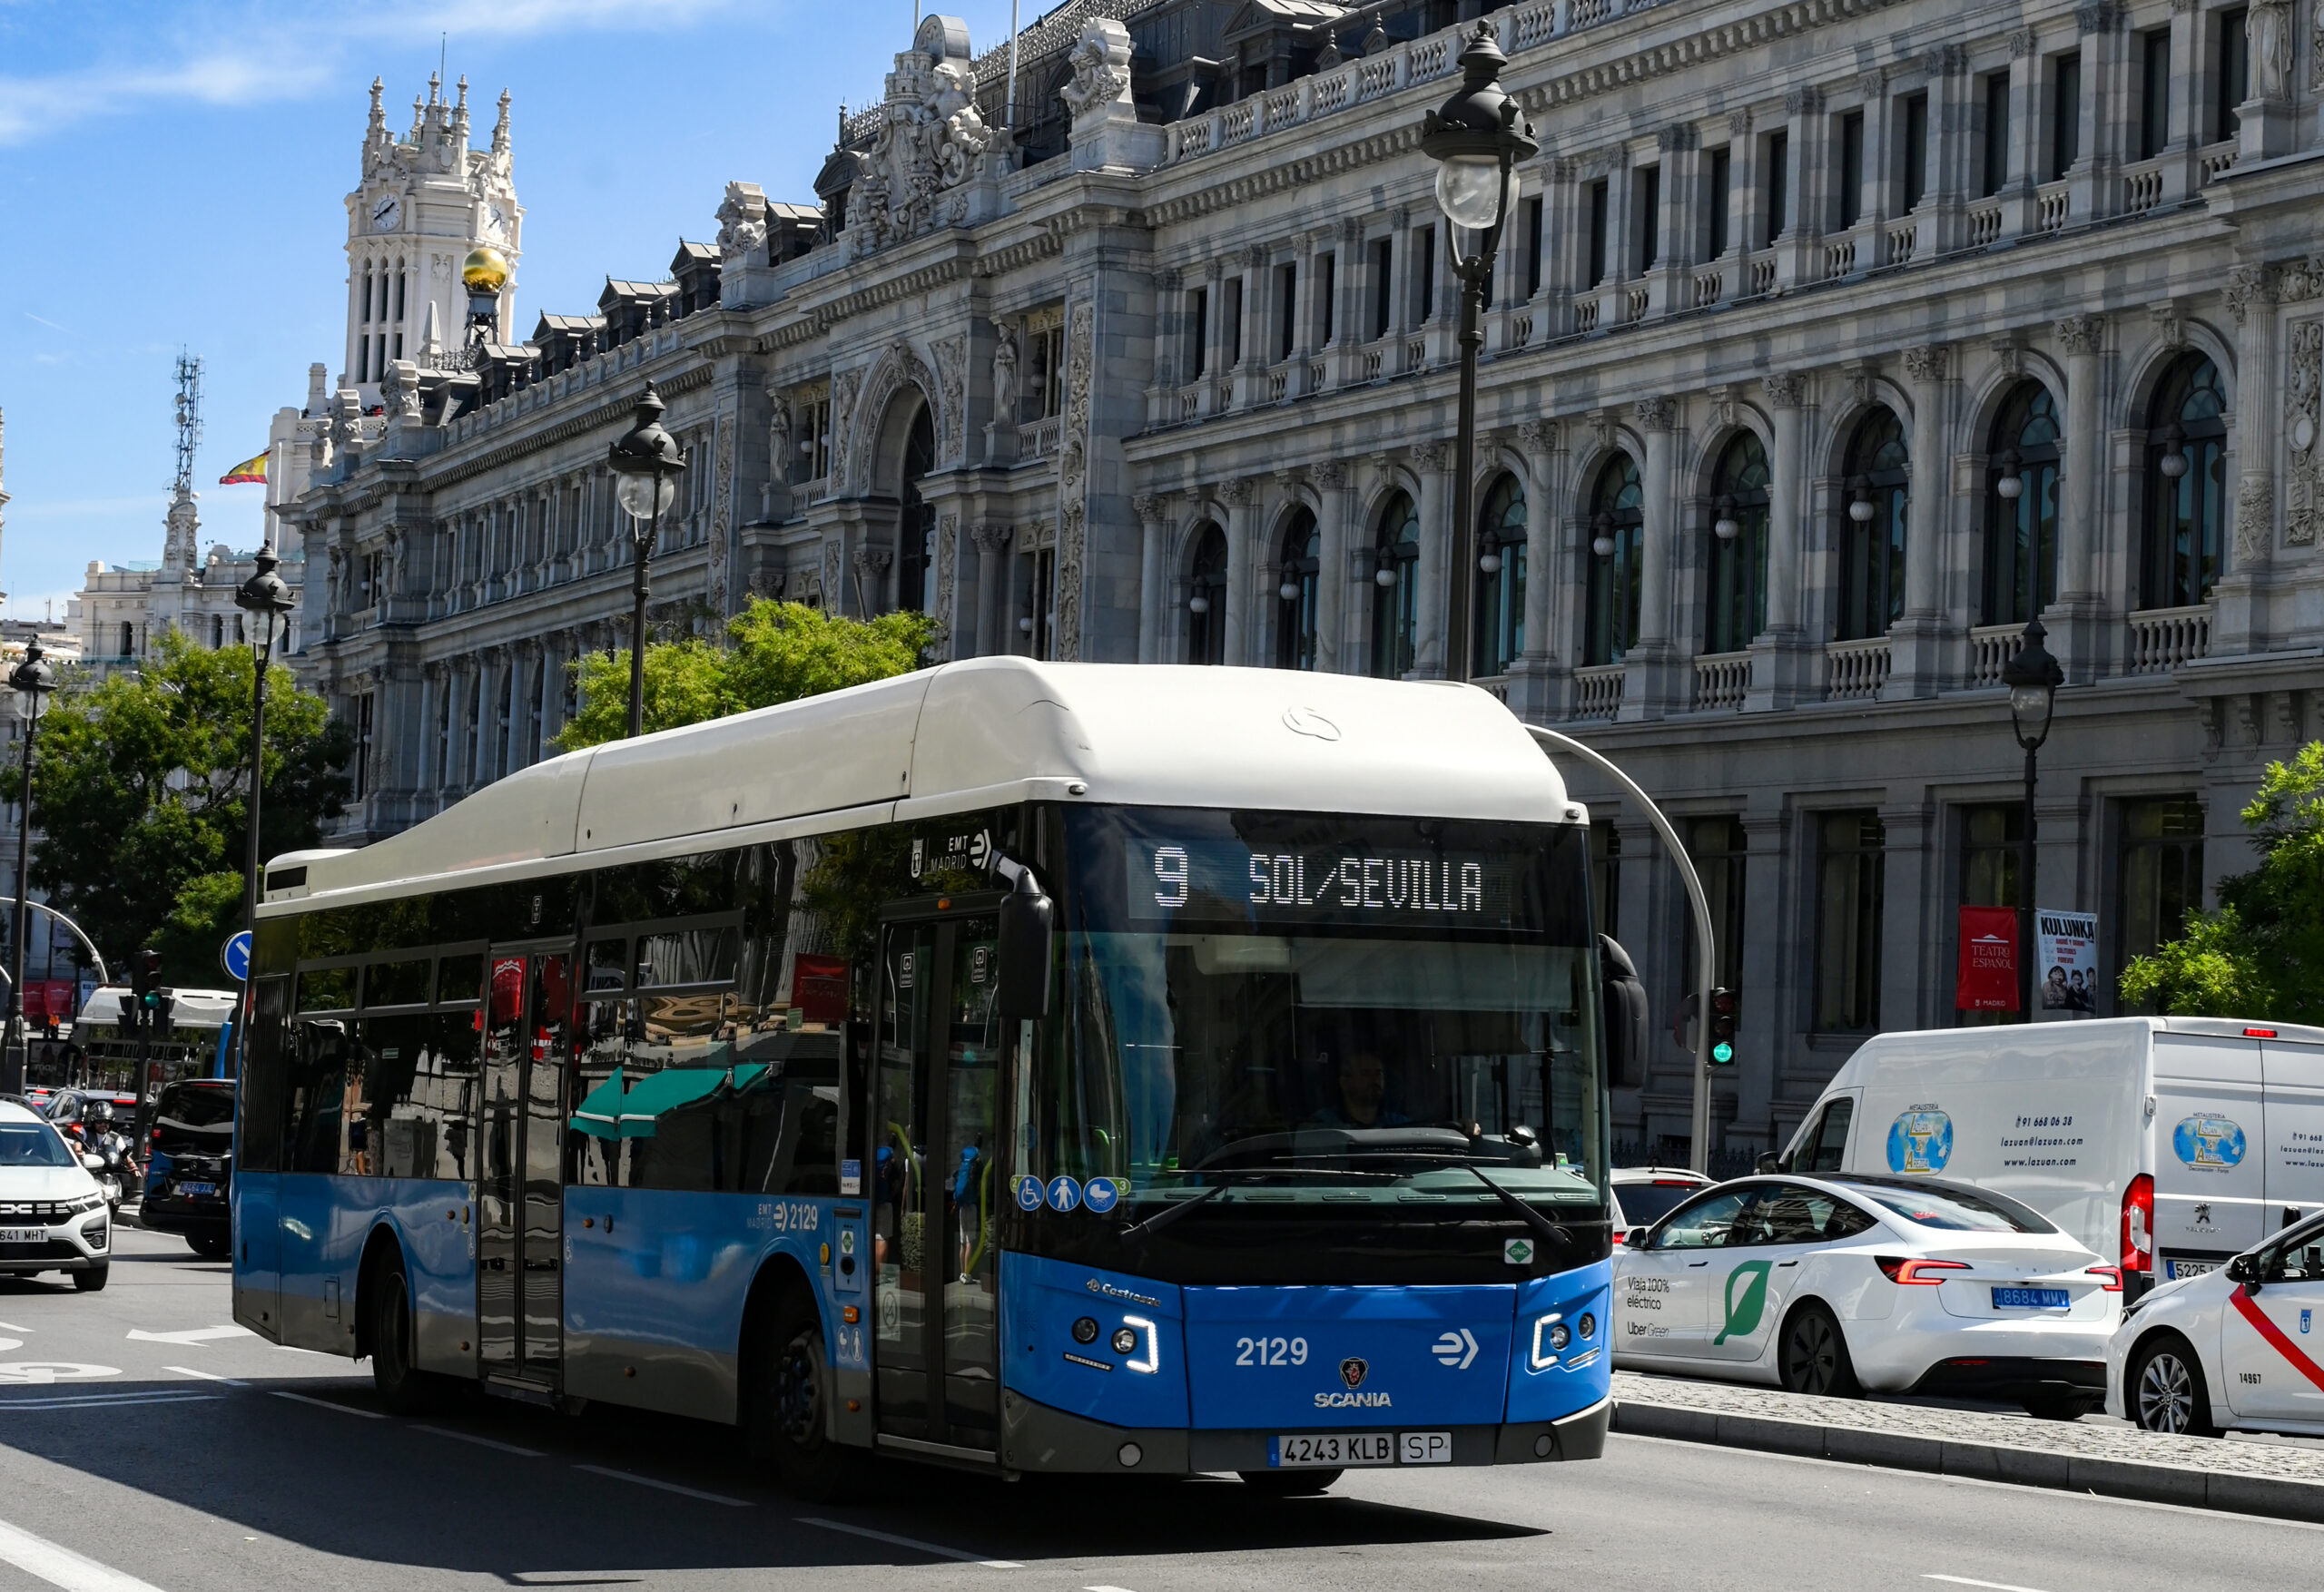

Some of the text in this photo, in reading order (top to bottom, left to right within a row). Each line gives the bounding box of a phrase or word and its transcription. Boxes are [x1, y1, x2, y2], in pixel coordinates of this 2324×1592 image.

[949, 835, 969, 851] EMT
[930, 853, 967, 872] MADRID
[1154, 846, 1482, 911] 9 SOL/SEVILLA
[2041, 917, 2095, 939] KULUNKA
[1972, 945, 2010, 958] TEATRO
[1973, 958, 2014, 969] ESPAÑOL
[2022, 1116, 2073, 1127] 91 668 06 38
[2001, 1136, 2083, 1146] lazuan@lazuan.com
[2004, 1156, 2077, 1167] www.lazuan.com
[1119, 1181, 1127, 1191] 3
[758, 1204, 772, 1214] EMT
[790, 1204, 818, 1231] 2129
[25, 1230, 45, 1241] MHT
[1628, 1276, 1670, 1294] Viaja 100%
[1627, 1294, 1661, 1310] eléctrico
[2004, 1290, 2038, 1304] 8684
[1627, 1322, 1669, 1337] Uber Green
[1236, 1337, 1308, 1366] 2129
[2239, 1372, 2261, 1384] 14967
[1314, 1392, 1392, 1408] SCANIA
[1285, 1438, 1340, 1461] 4243
[1348, 1437, 1389, 1460] KLB
[1408, 1436, 1444, 1459] SP
